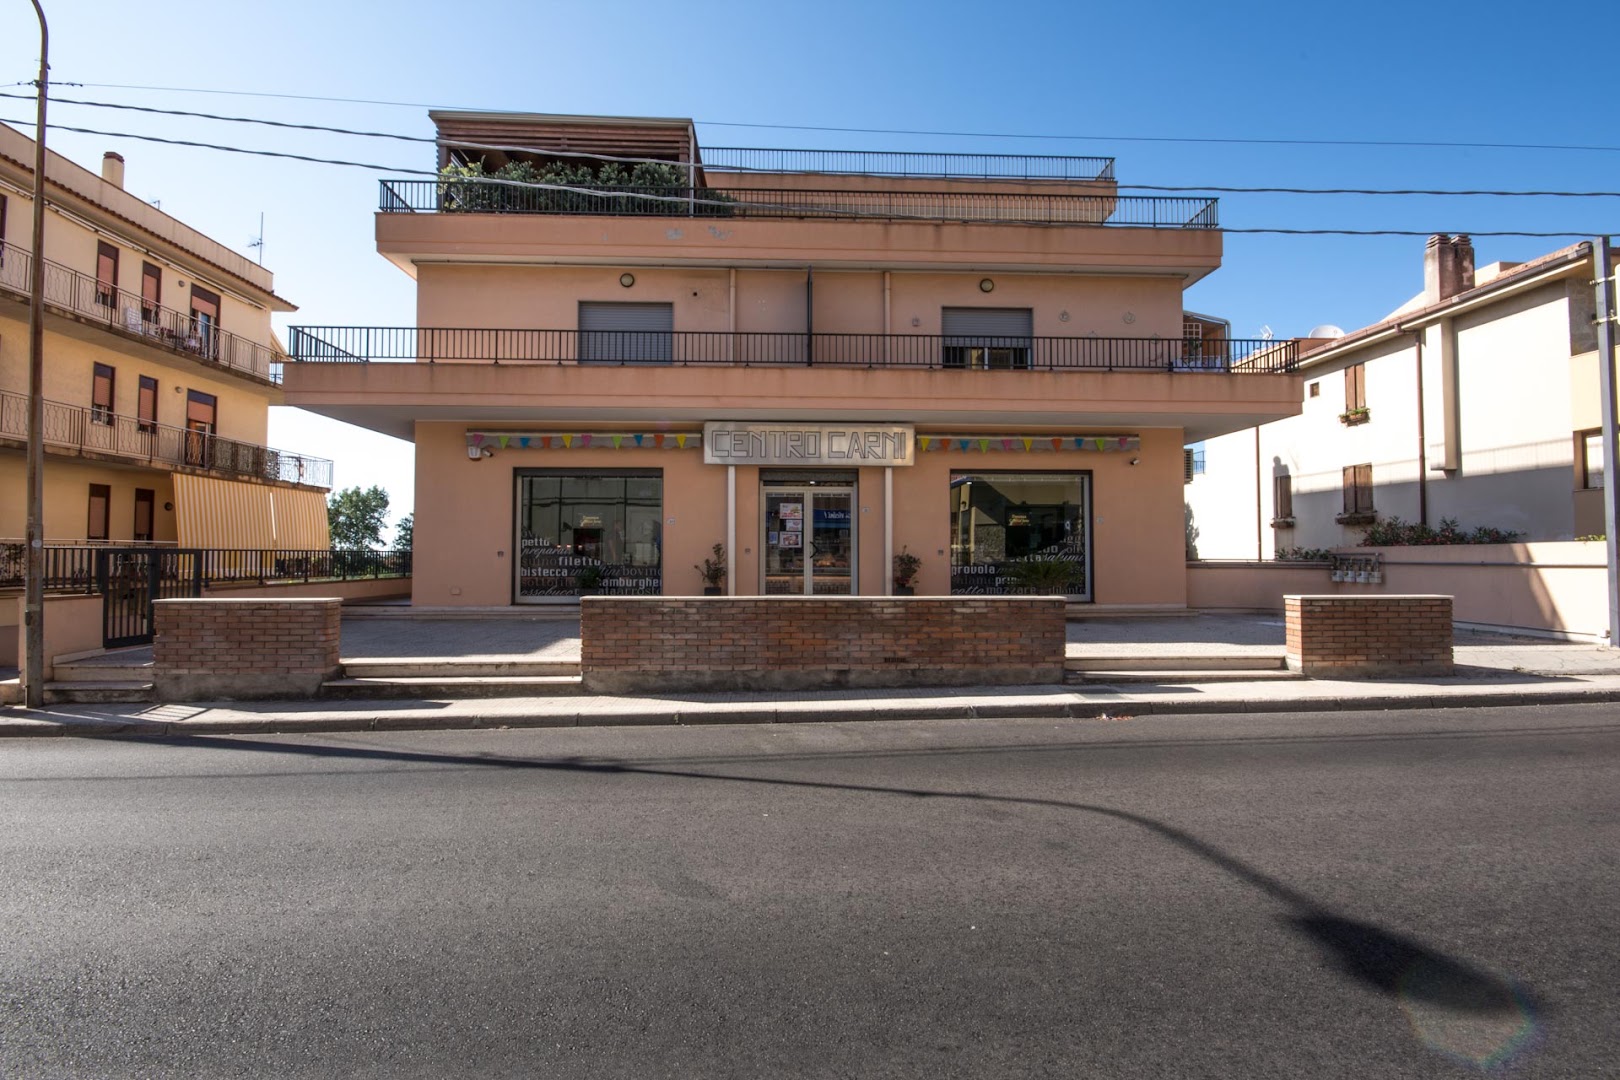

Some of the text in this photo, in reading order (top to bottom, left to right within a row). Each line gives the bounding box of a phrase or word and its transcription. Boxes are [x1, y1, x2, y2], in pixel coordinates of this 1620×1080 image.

[711, 430, 906, 460] CENTRO CARNI
[521, 566, 568, 576] bistecca
[951, 564, 995, 576] provola
